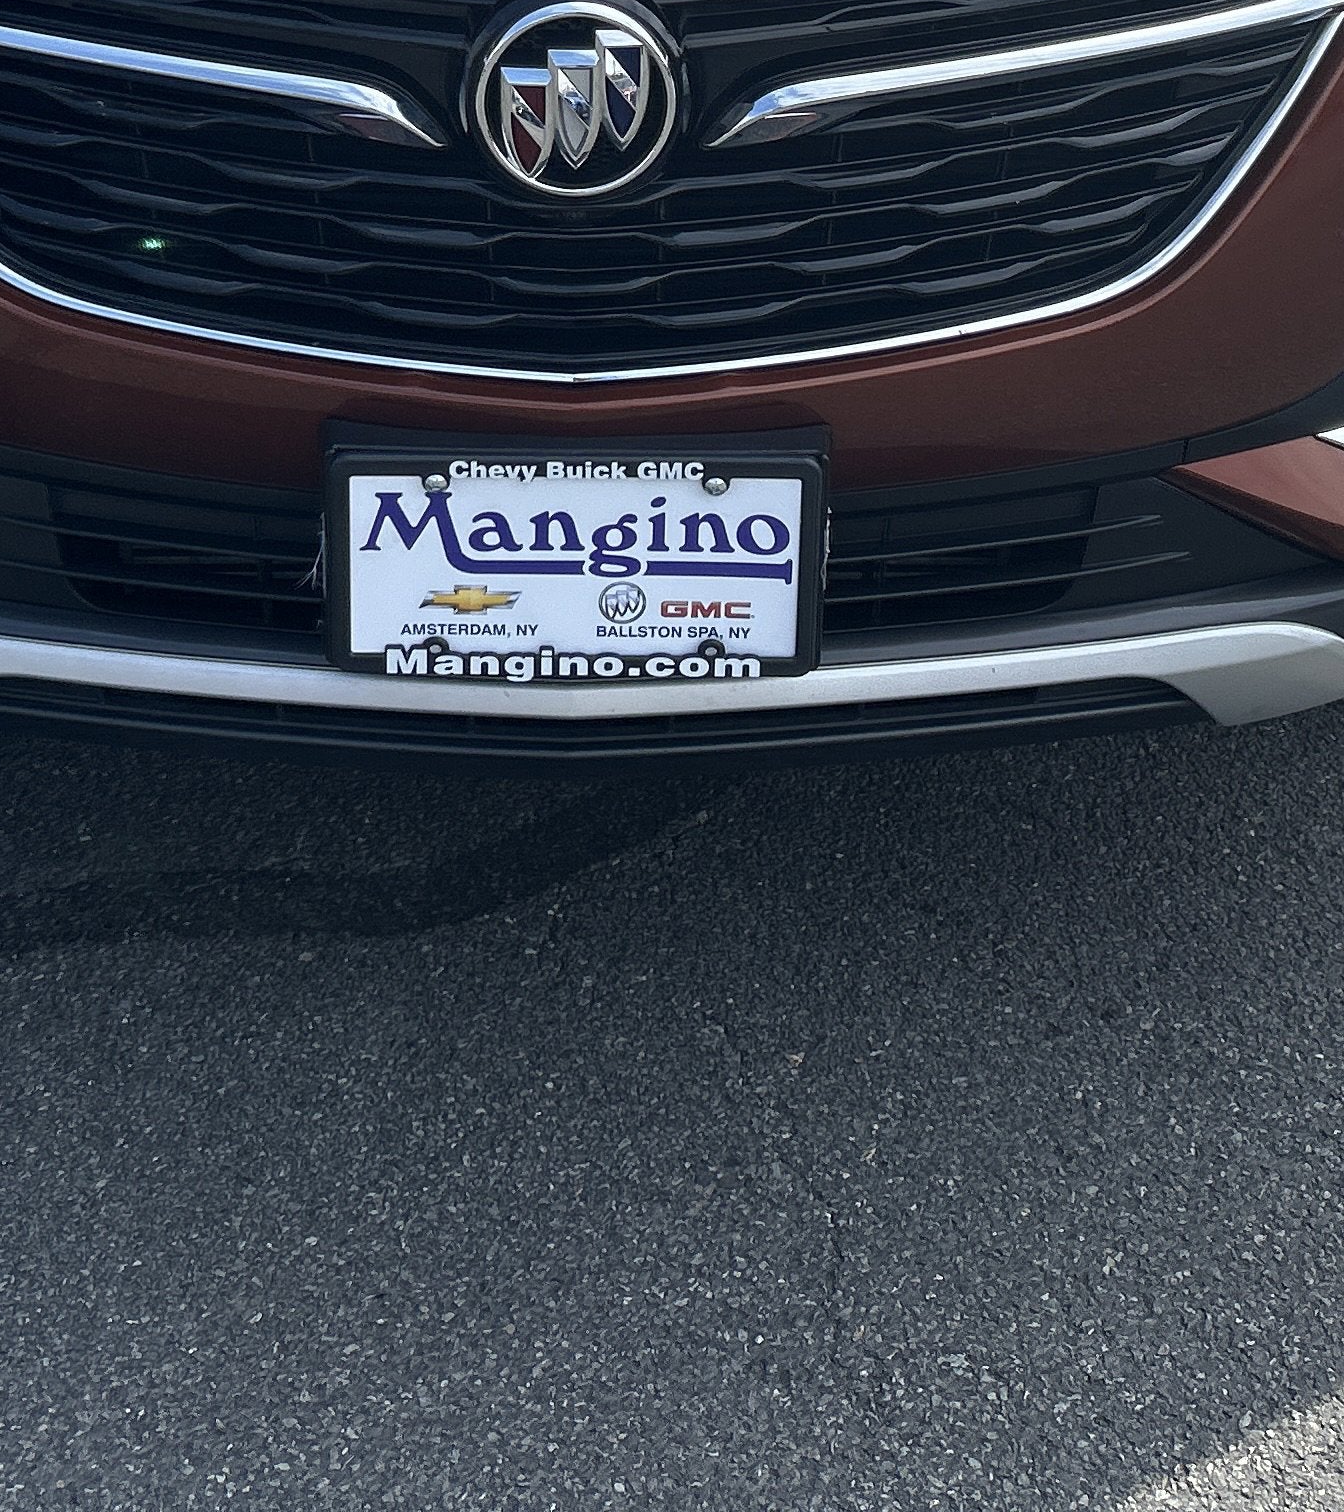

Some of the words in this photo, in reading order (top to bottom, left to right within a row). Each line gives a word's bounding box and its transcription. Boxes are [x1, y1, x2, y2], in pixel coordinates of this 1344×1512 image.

[448, 459, 537, 482] Chevy
[546, 461, 627, 481] Buick
[636, 462, 705, 481] GMC
[359, 491, 793, 585] Mangino
[660, 600, 754, 619] GMC
[400, 623, 512, 638] AMSTERDAM,
[516, 624, 539, 637] NY
[596, 625, 682, 639] BALLSTON
[687, 626, 725, 641] SPA,
[729, 628, 751, 639] NY
[385, 646, 761, 682] Mangino.com
